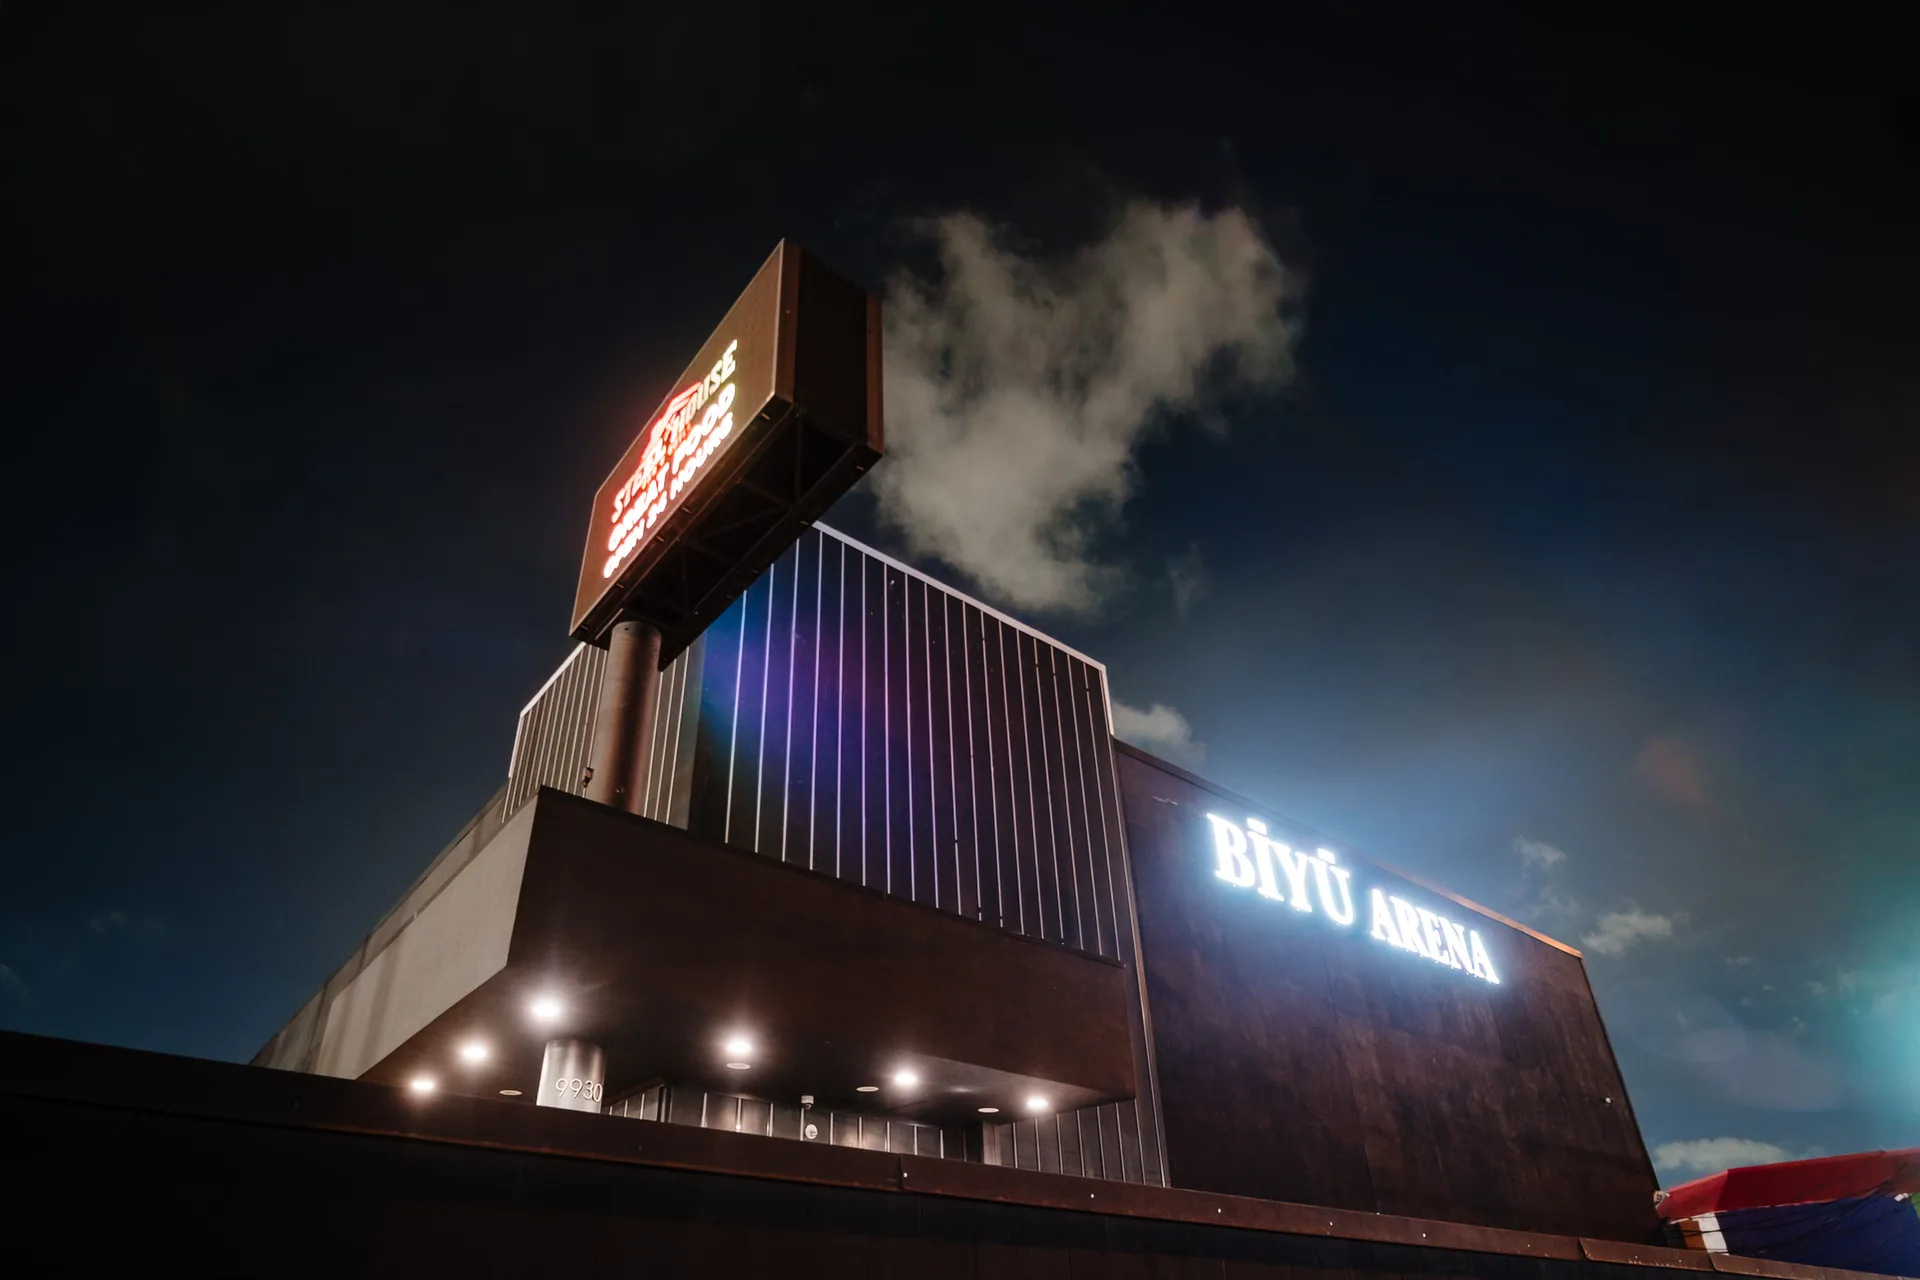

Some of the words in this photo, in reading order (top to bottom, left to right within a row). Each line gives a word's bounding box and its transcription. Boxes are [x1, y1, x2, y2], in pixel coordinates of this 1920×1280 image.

[603, 518, 646, 579] OPEN
[646, 490, 668, 529] 24
[670, 411, 734, 501] HOURS
[607, 462, 670, 552] GREAT
[671, 382, 736, 475] FOOD
[1369, 887, 1501, 985] ARENA
[556, 1078, 603, 1103] 9930
